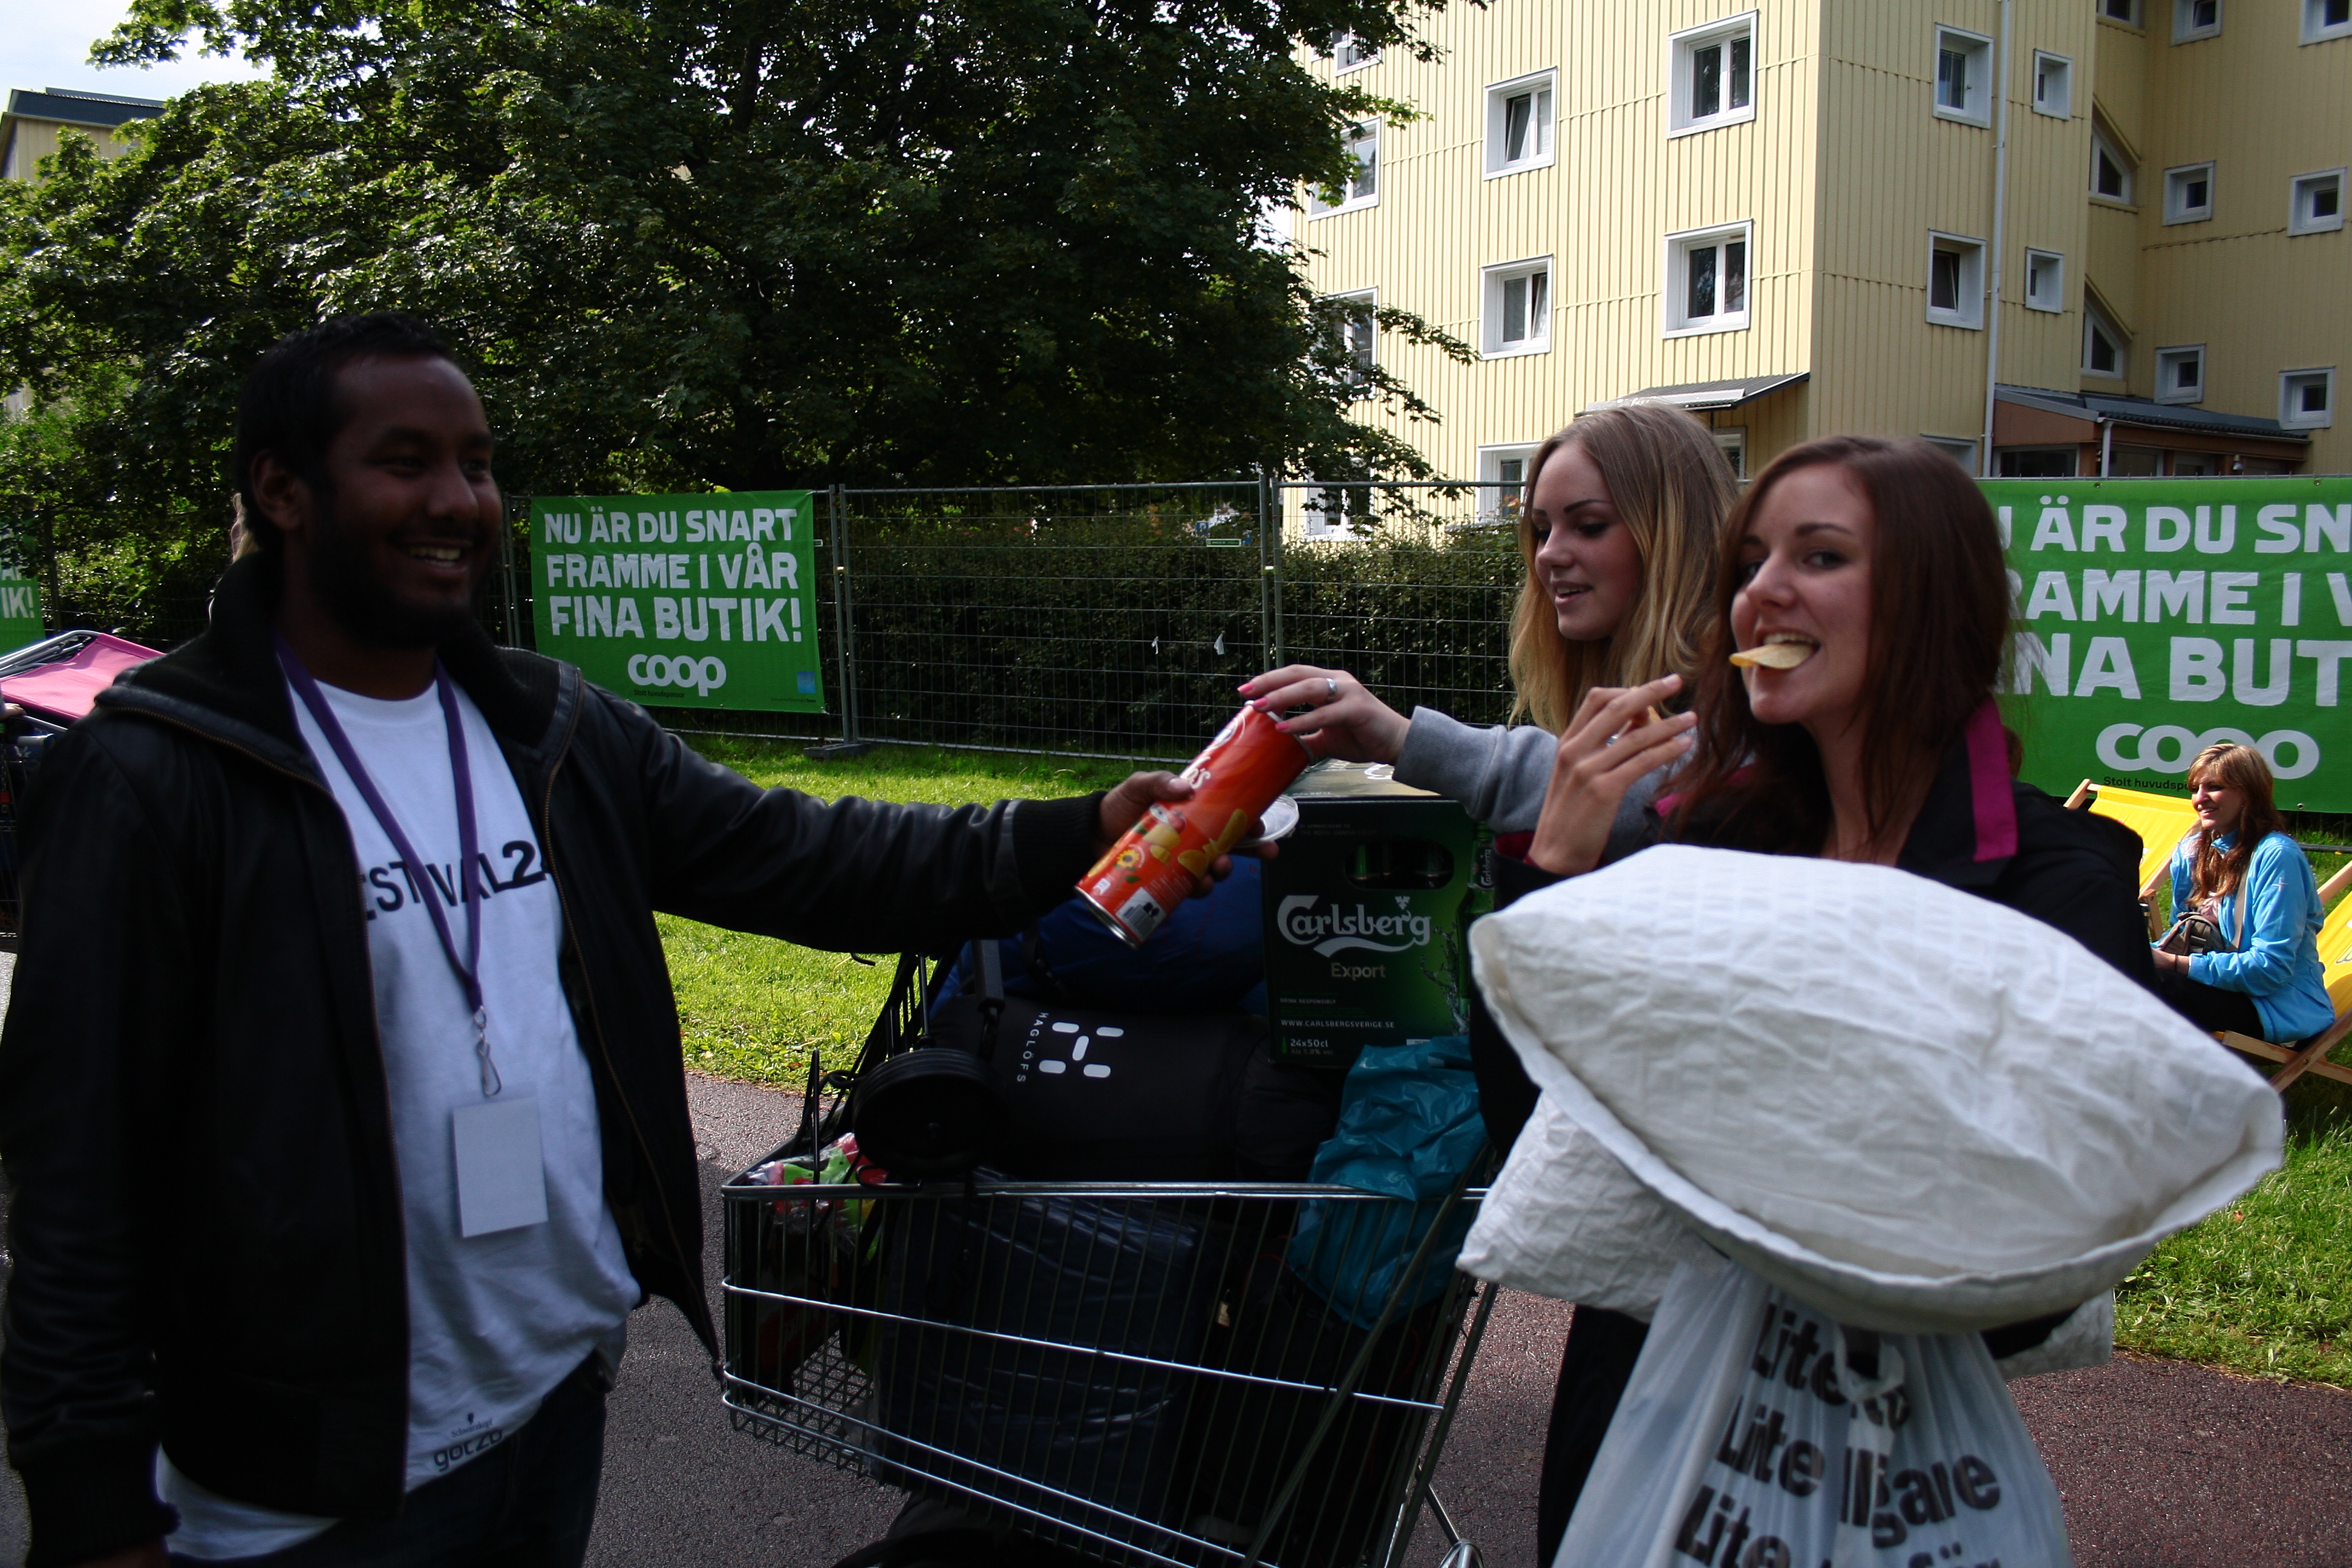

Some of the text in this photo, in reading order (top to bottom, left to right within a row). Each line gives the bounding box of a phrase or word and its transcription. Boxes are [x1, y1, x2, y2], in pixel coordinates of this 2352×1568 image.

[544, 506, 798, 543] NU ÄR DU SNART
[2030, 495, 2127, 552] ÄR
[2145, 505, 2236, 554] DU
[547, 542, 799, 589] FRAMME I VÅR
[549, 595, 802, 642] FINA BUTIK!
[2281, 572, 2301, 626] I
[2103, 776, 2132, 786] Stolt
[1277, 895, 1431, 946] Carlsberg
[1331, 962, 1387, 981] Export
[1017, 1012, 1049, 1082] HAGLÖFS
[1290, 1038, 1328, 1047] 24x50cl
[1716, 1394, 1824, 1498] Lite
